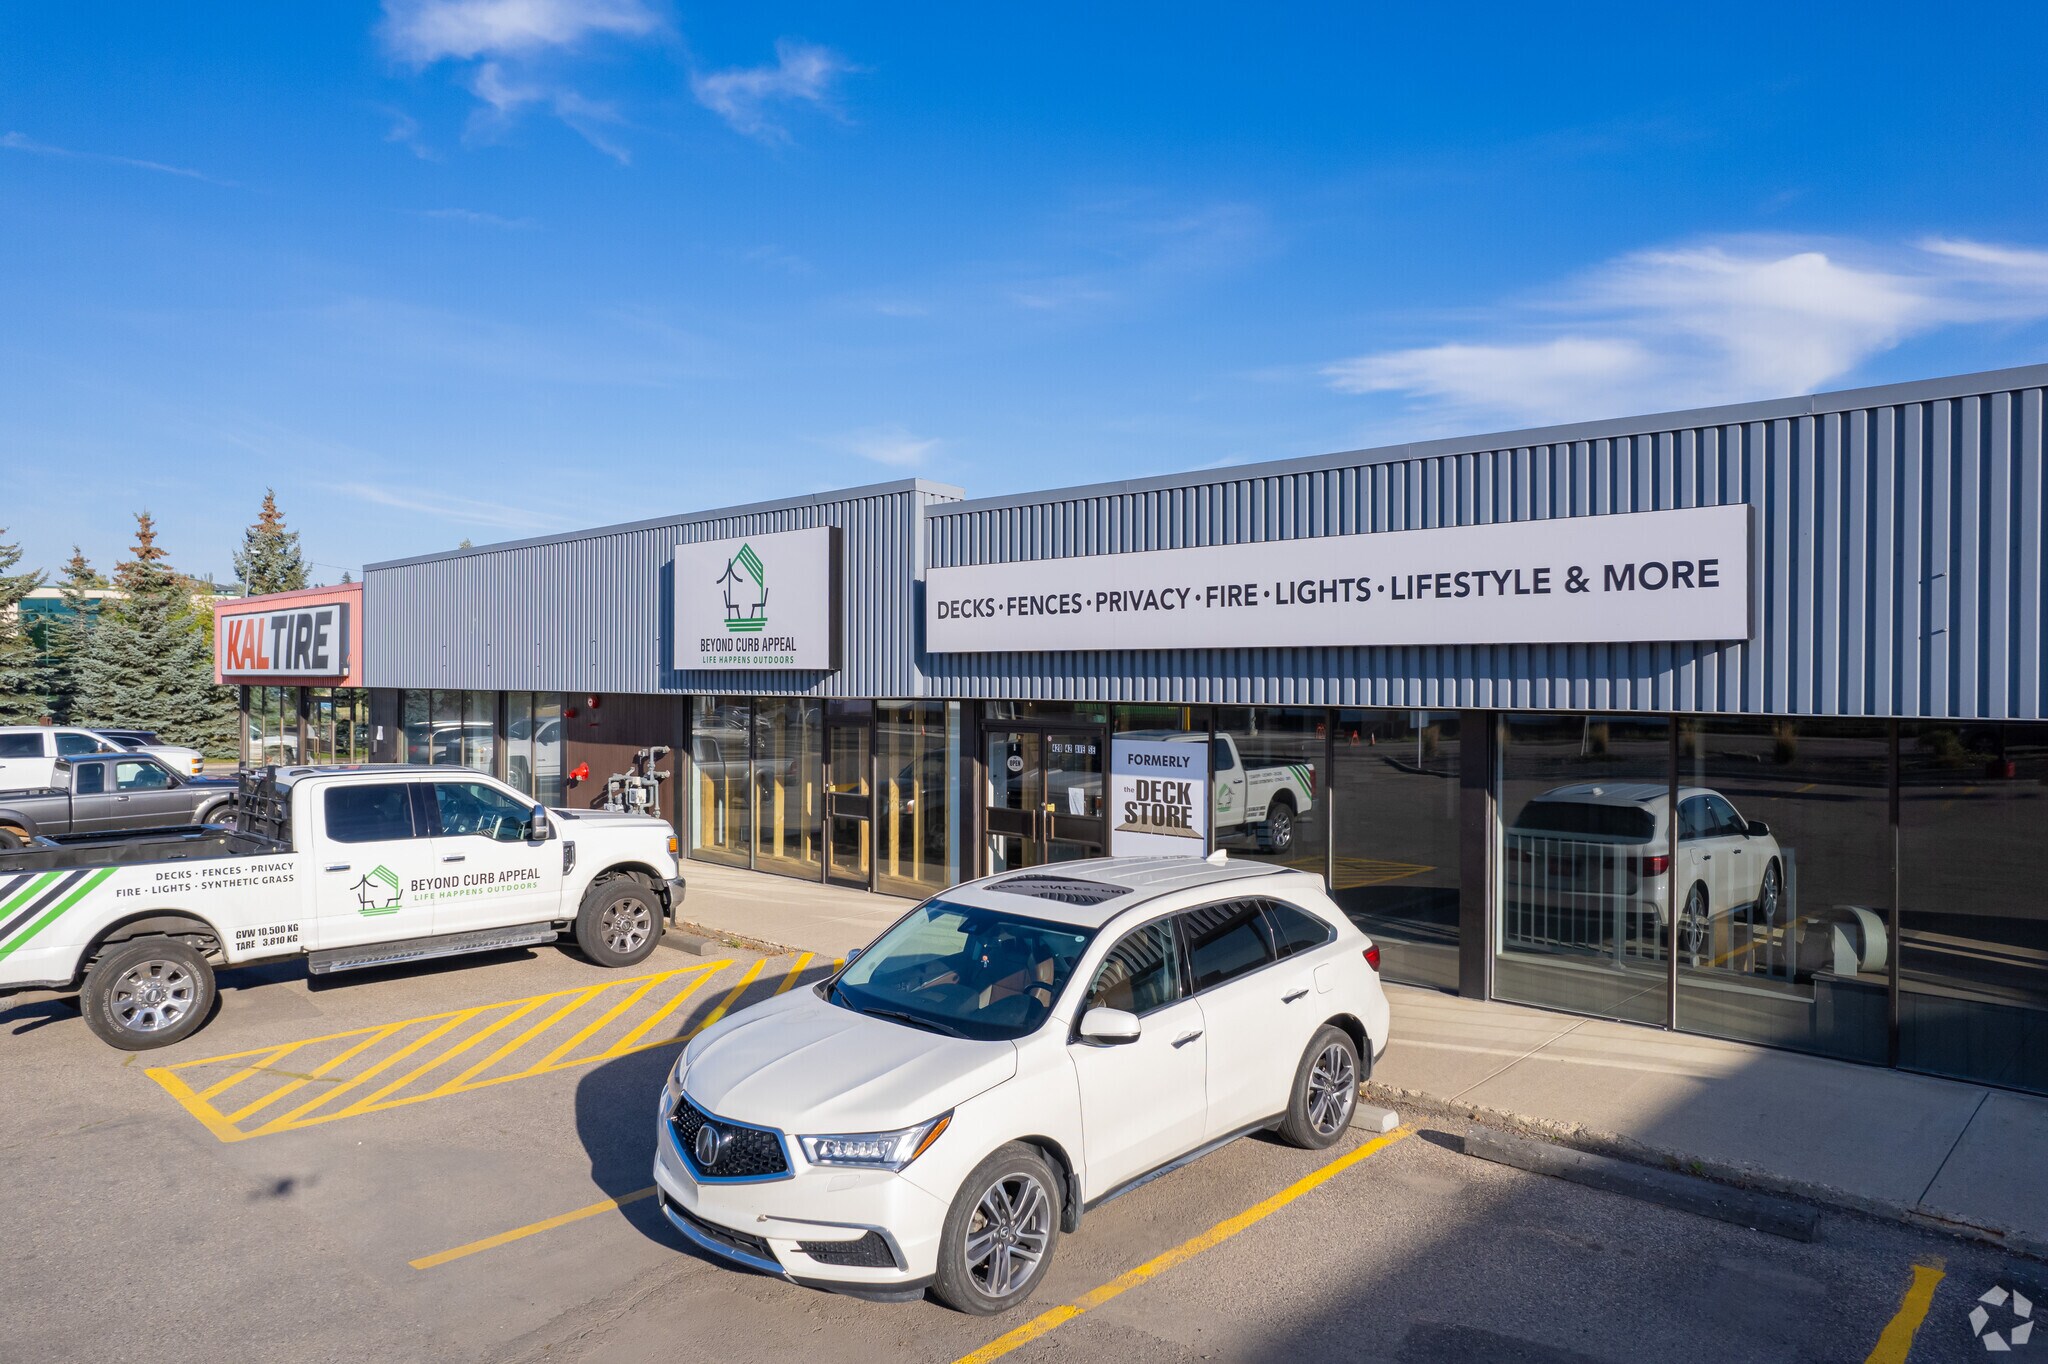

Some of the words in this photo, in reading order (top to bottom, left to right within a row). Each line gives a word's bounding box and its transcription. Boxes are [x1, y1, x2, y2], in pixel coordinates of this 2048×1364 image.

[937, 597, 995, 620] DECKS
[1006, 592, 1082, 617] FENCES
[1095, 587, 1191, 613] PRIVACY
[1206, 583, 1258, 608] FIRE
[1275, 576, 1372, 605] LIGHTS
[1391, 567, 1551, 600] LIFESTYLE
[1564, 565, 1590, 593] &
[1603, 558, 1720, 592] MORE
[700, 638, 734, 652] BEYOND
[736, 637, 760, 652] CURB
[762, 636, 797, 652] APPEAL
[702, 656, 717, 664] LIFE
[718, 656, 751, 664] HAPPENS
[753, 655, 794, 664] OUTDOORS
[1128, 753, 1190, 768] FORMERLY
[1136, 779, 1192, 805] DECK
[1124, 801, 1192, 829] STORE
[156, 870, 192, 881] DECKS
[202, 866, 242, 877] FENCES
[251, 862, 294, 873] PRIVACY
[411, 876, 459, 892] BEYOND
[463, 872, 495, 886] CURB
[498, 868, 540, 883] APPEAL
[116, 888, 141, 897] FIRE
[152, 883, 191, 894] LIGHTS
[201, 877, 259, 890] SYNTHETIC
[262, 874, 294, 884] GRASS
[414, 892, 435, 901] LIFE
[439, 887, 483, 898] HAPPENS
[487, 882, 537, 893] OUTDOORS
[236, 929, 256, 939] GVW
[287, 923, 299, 932] KG
[236, 940, 255, 951] TARE
[286, 934, 298, 943] KG
